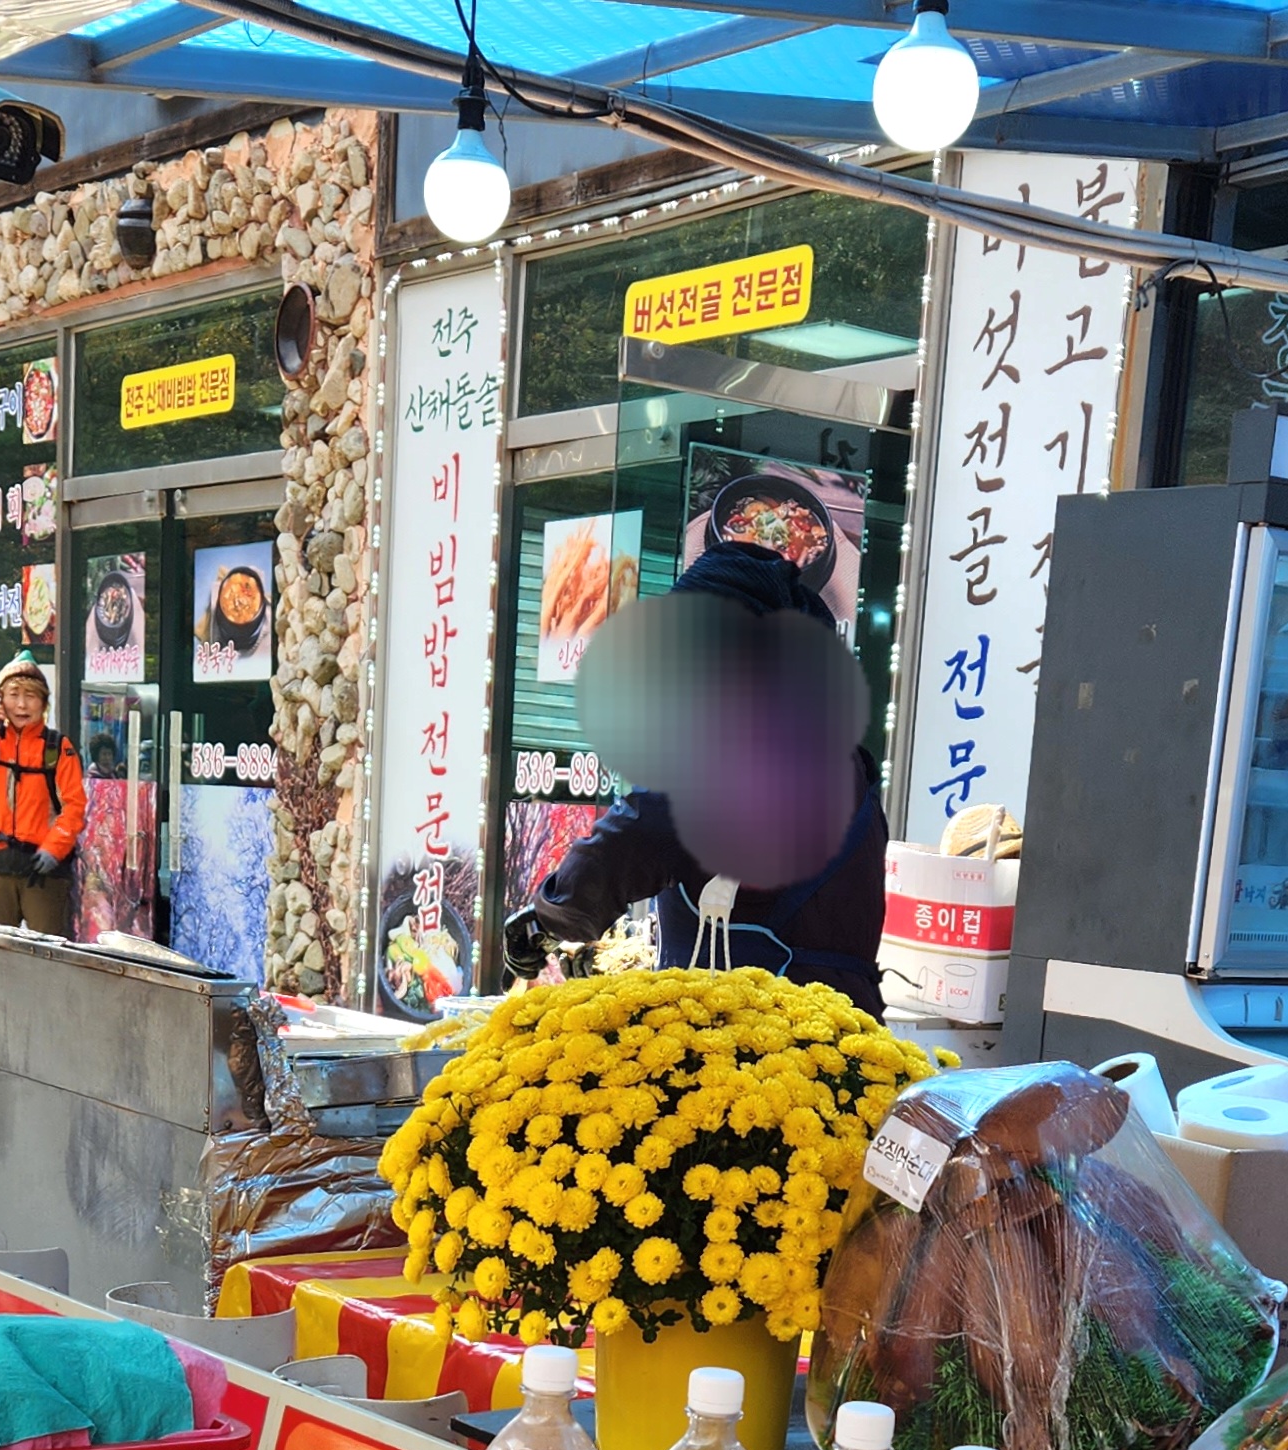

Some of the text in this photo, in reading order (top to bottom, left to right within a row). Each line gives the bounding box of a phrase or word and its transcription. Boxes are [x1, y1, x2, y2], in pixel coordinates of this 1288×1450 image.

[633, 262, 804, 334] 버섯전골 전문점
[432, 306, 479, 357] 전주
[125, 366, 230, 419] 전주 산채비빔밥 전문점
[405, 372, 502, 432] 산채돌솥
[197, 640, 240, 675] 청국장
[413, 452, 461, 933] 비빔밥 전문점
[915, 903, 981, 935] 종이컵
